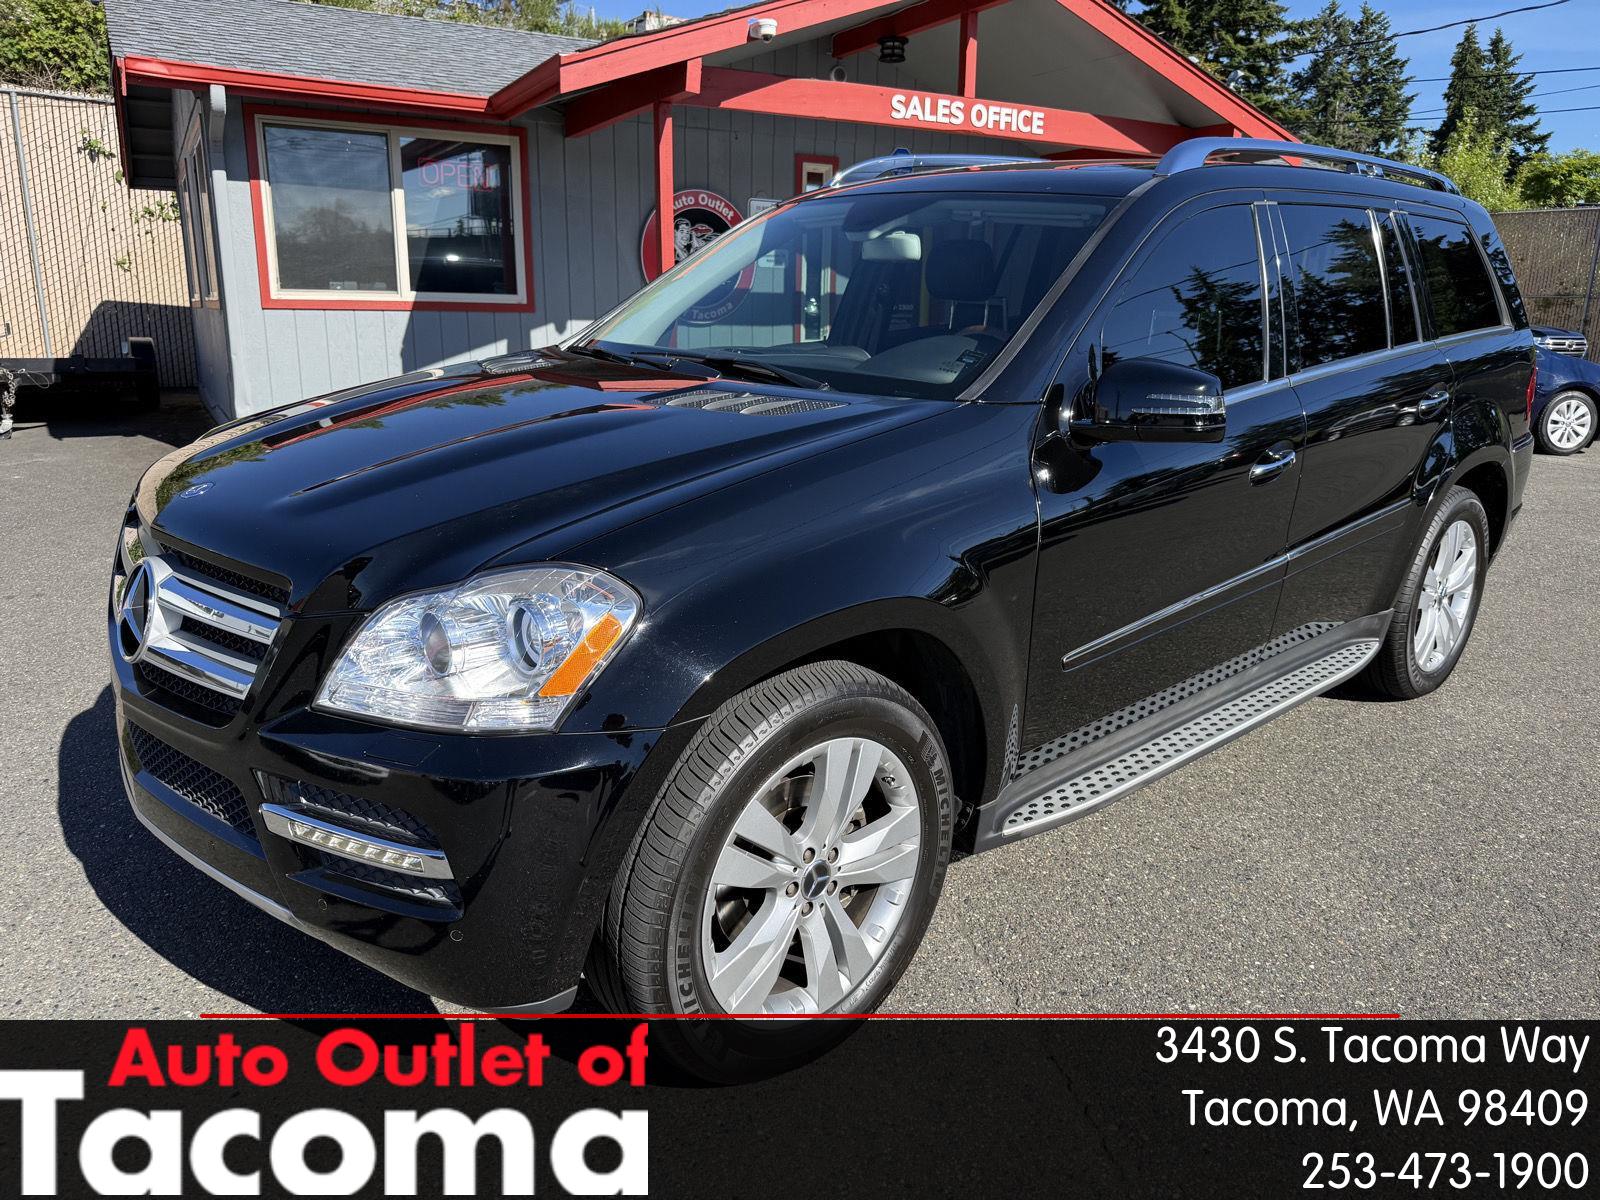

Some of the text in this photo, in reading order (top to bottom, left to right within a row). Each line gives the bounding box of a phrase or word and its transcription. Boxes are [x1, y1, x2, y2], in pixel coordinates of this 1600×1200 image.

[890, 94, 1045, 135] SALES OFFICE
[421, 161, 491, 190] OPEN
[674, 193, 734, 220] uto Outlet
[691, 302, 734, 320] Tacoma
